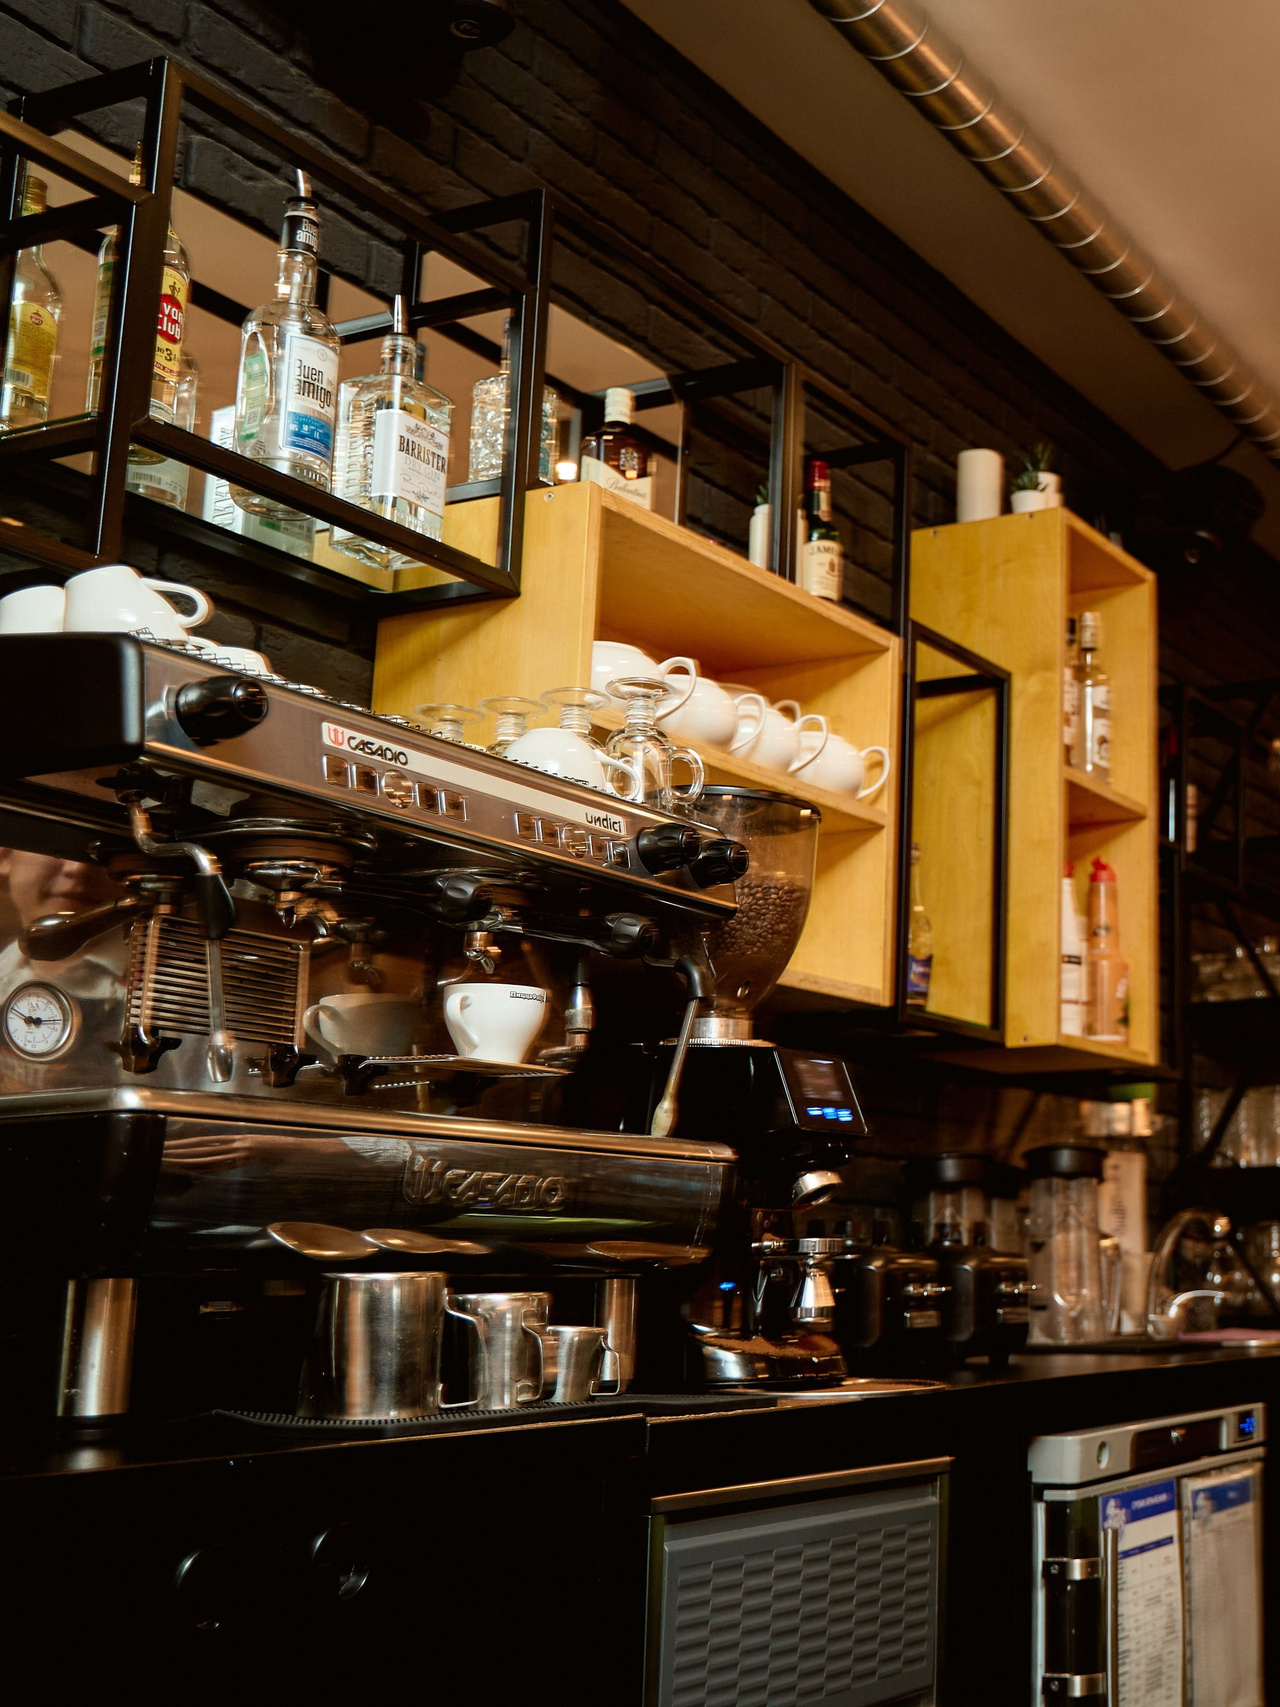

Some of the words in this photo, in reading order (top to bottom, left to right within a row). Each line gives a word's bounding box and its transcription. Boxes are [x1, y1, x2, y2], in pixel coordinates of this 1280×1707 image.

[296, 229, 319, 252] amig
[161, 301, 185, 323] van
[295, 359, 324, 385] Buen
[294, 378, 332, 409] amigo
[399, 434, 447, 475] BARRISTER
[405, 456, 422, 471] DRY
[425, 466, 440, 481] GIN
[347, 735, 409, 767] CASADIO
[585, 812, 623, 834] undici
[442, 1168, 565, 1208] CASADIO
